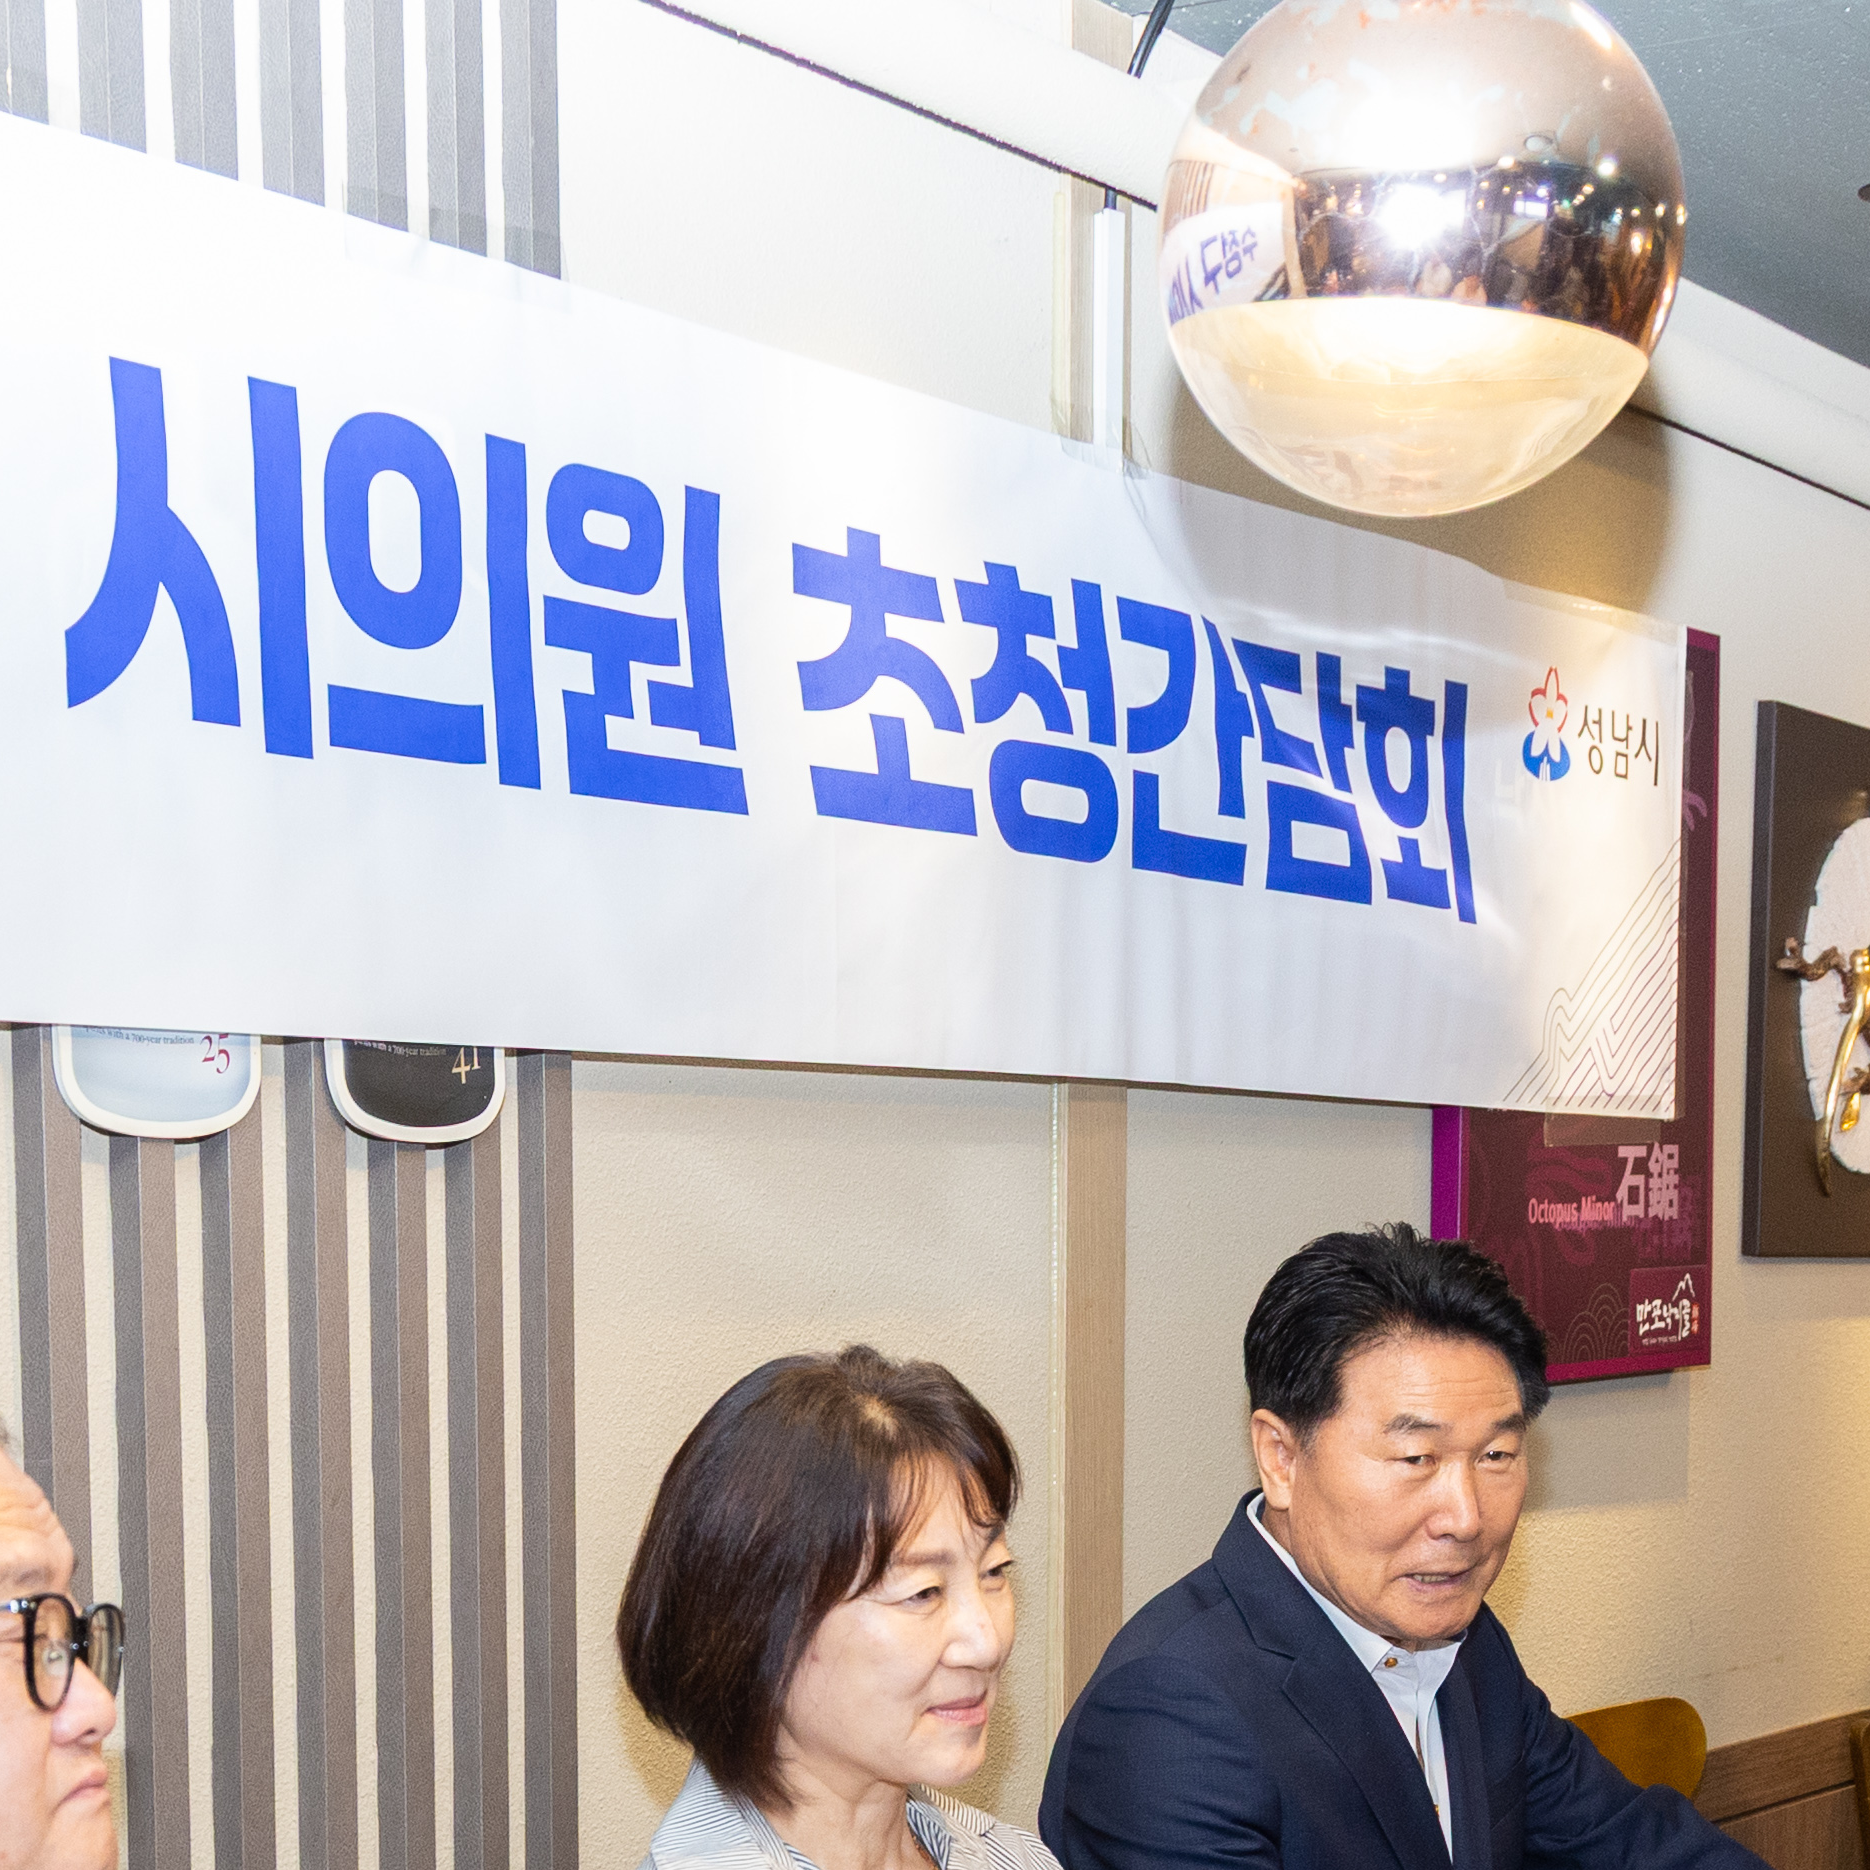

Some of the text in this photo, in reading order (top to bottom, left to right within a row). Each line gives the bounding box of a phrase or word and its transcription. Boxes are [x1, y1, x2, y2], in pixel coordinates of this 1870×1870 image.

[64, 356, 749, 816] 시의원
[792, 526, 1477, 924] 초청간담회
[1577, 703, 1660, 787] 성남시
[132, 1033, 162, 1046] 700-year
[163, 1034, 195, 1045] tradition
[200, 1033, 230, 1074] 25
[452, 1046, 481, 1085] 41
[1528, 1195, 1615, 1226] Octopus Minor
